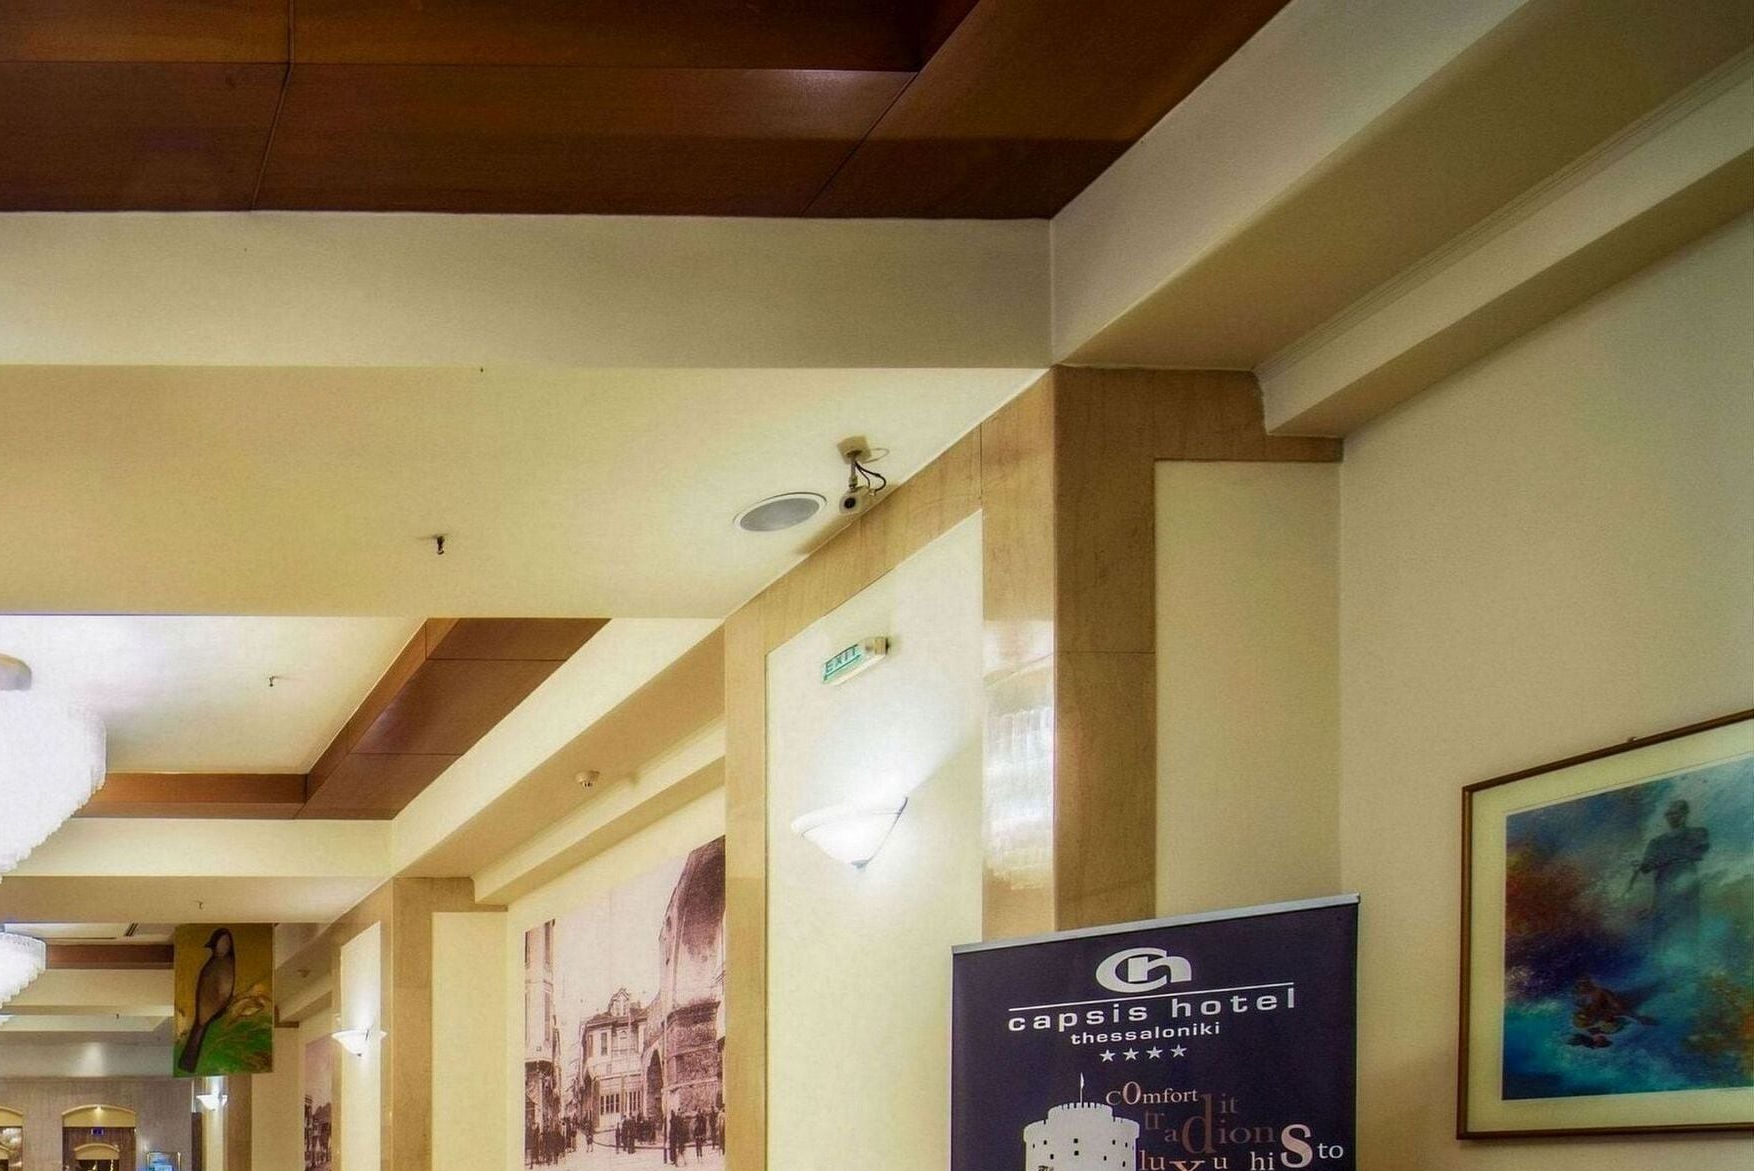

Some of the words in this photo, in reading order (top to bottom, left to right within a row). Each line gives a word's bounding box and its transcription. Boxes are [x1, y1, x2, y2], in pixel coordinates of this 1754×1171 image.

[825, 646, 856, 674] EXIT
[1008, 1003, 1148, 1032] capsis
[1171, 987, 1295, 1018] hotel
[1071, 1021, 1220, 1045] thessaloniki
